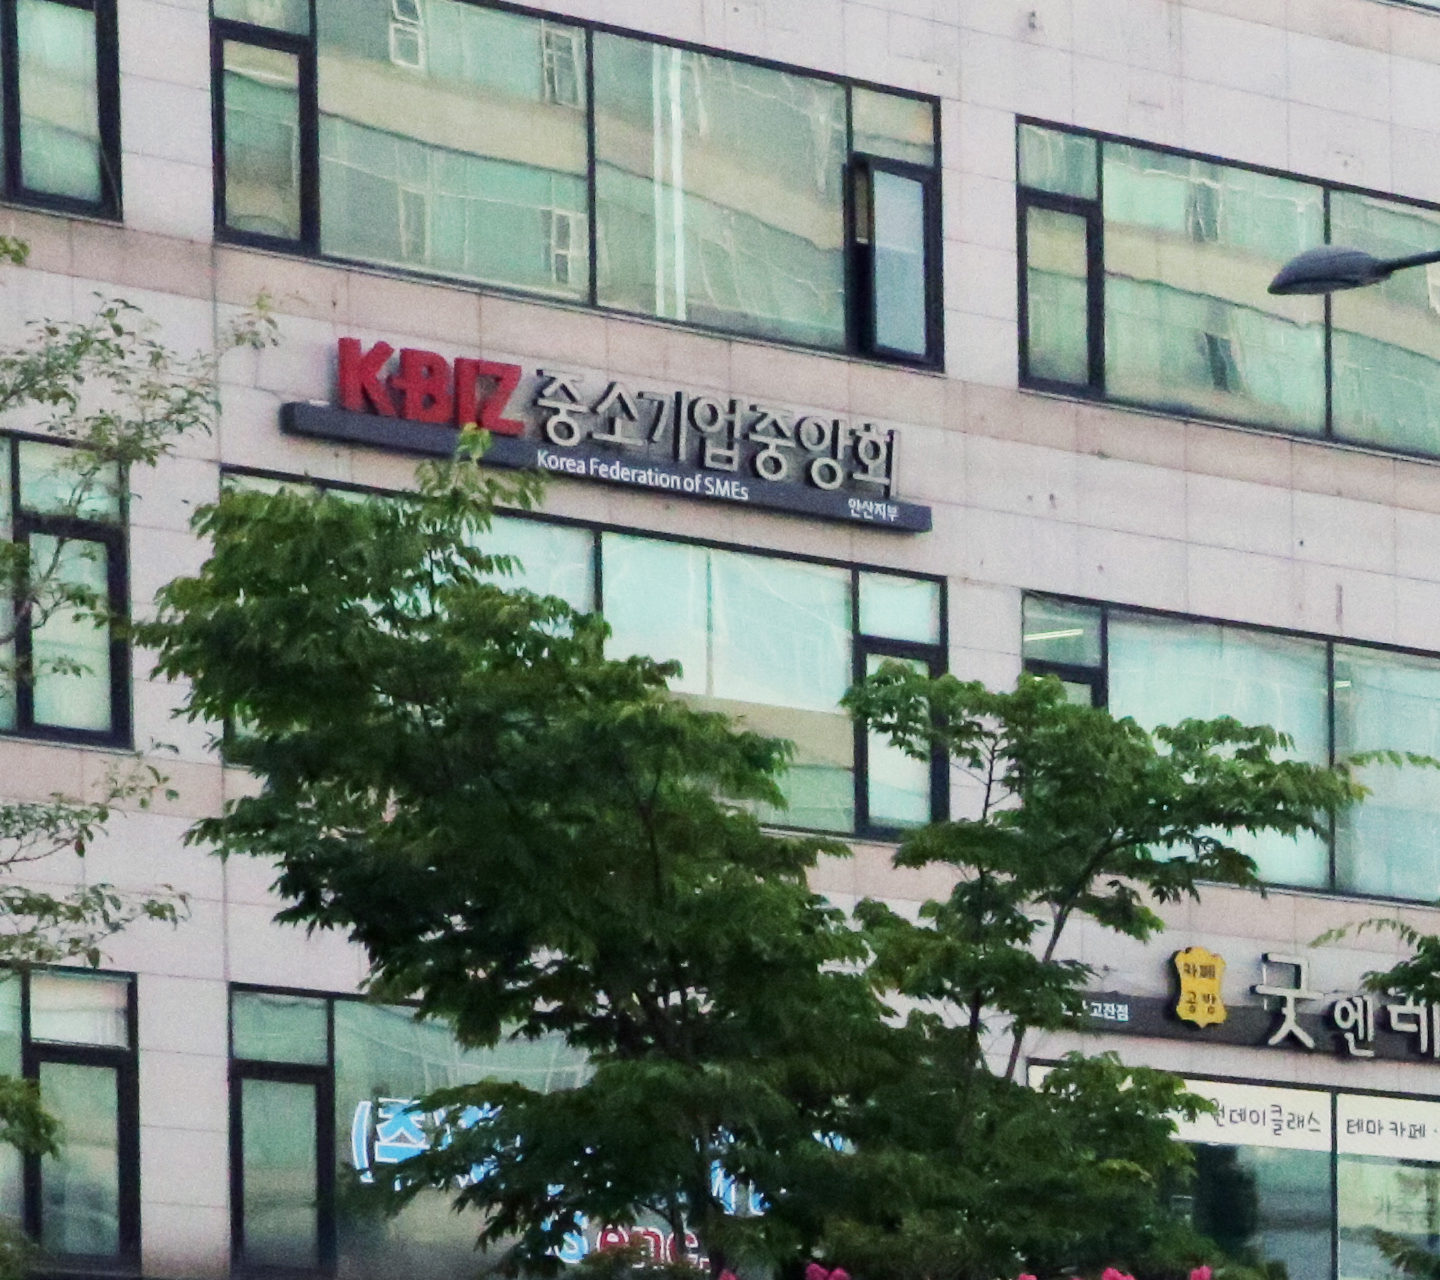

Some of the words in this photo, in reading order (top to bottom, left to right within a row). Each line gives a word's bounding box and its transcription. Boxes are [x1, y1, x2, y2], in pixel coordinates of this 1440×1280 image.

[338, 337, 526, 436] KBIZ
[536, 368, 902, 498] 중소기업중앙회
[536, 450, 587, 476] Korea
[589, 456, 683, 491] Federation
[684, 474, 702, 494] of
[704, 480, 749, 501] SMEs
[1182, 962, 1217, 980] 카페
[1187, 991, 1216, 1015] 공방
[1346, 1118, 1384, 1136] 테마
[1388, 1121, 1427, 1140] 카페
